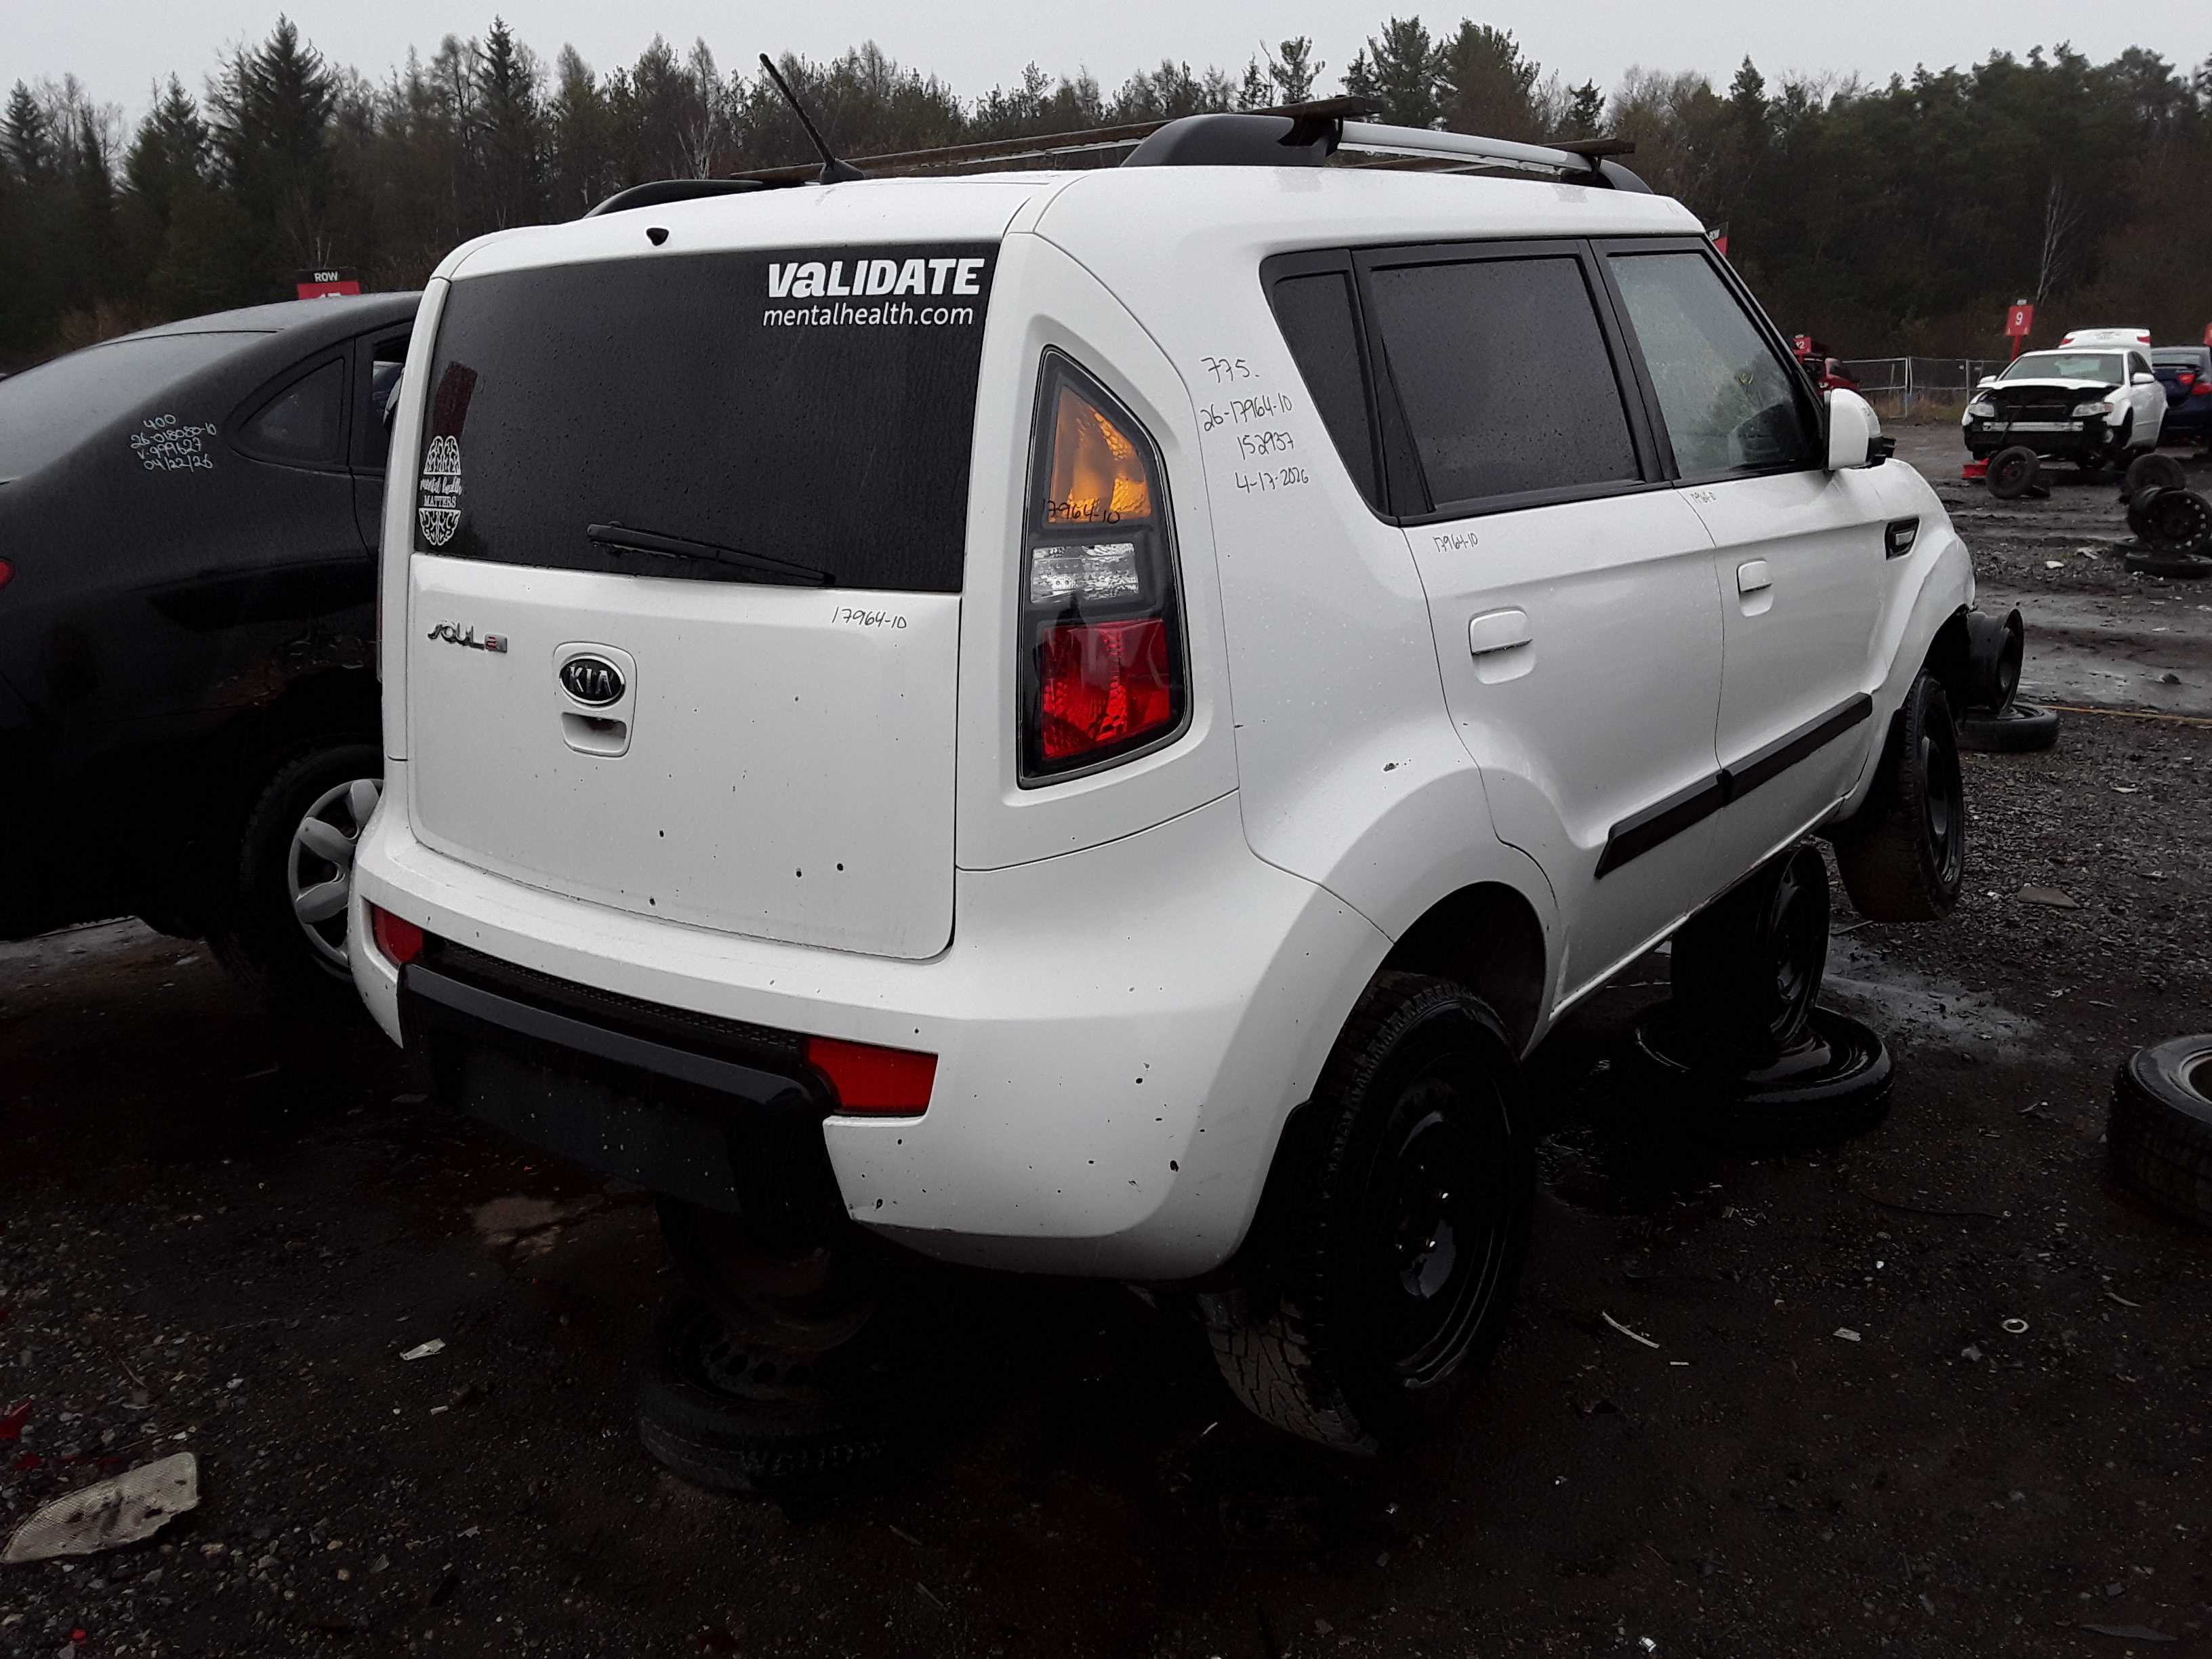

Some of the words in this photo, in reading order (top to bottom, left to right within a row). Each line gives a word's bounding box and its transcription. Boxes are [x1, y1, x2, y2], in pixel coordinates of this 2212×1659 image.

[314, 271, 338, 282] ROW
[763, 302, 973, 326] mentalhealth.com
[2015, 312, 2023, 325] 9
[143, 414, 176, 430] 400
[424, 495, 457, 508] MATTERS
[832, 607, 907, 629] 17964-10
[569, 665, 613, 696] KIA
